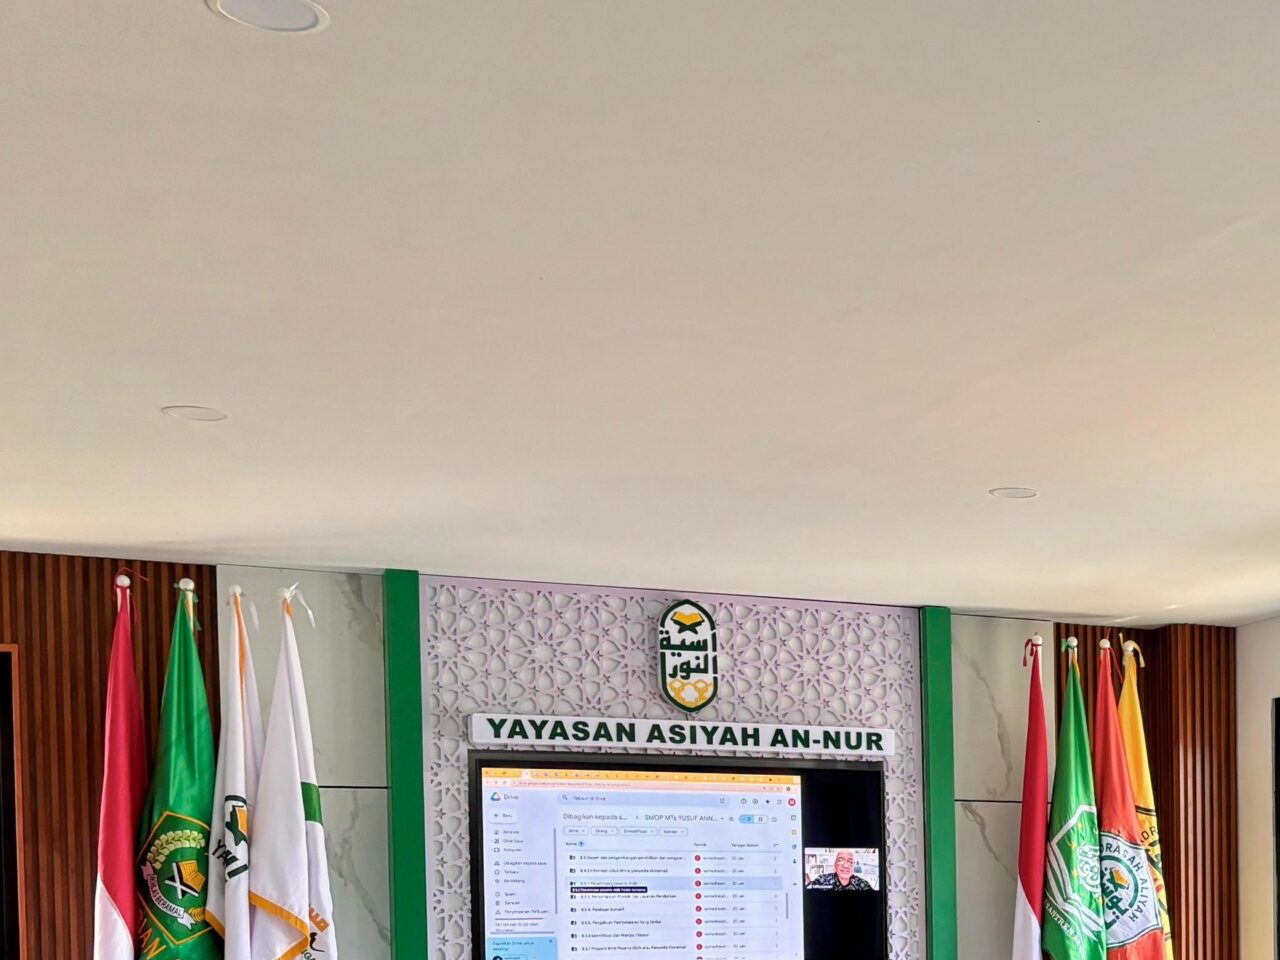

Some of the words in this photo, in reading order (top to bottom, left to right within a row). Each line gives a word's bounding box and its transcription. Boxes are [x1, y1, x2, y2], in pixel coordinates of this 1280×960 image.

[487, 718, 636, 743] YAYASAN
[647, 724, 761, 747] ASIYAH
[770, 728, 884, 751] AN-NUR
[563, 813, 594, 821] Dibagikan
[156, 897, 184, 918] BERAMAL
[1128, 877, 1149, 922] ALIYAH
